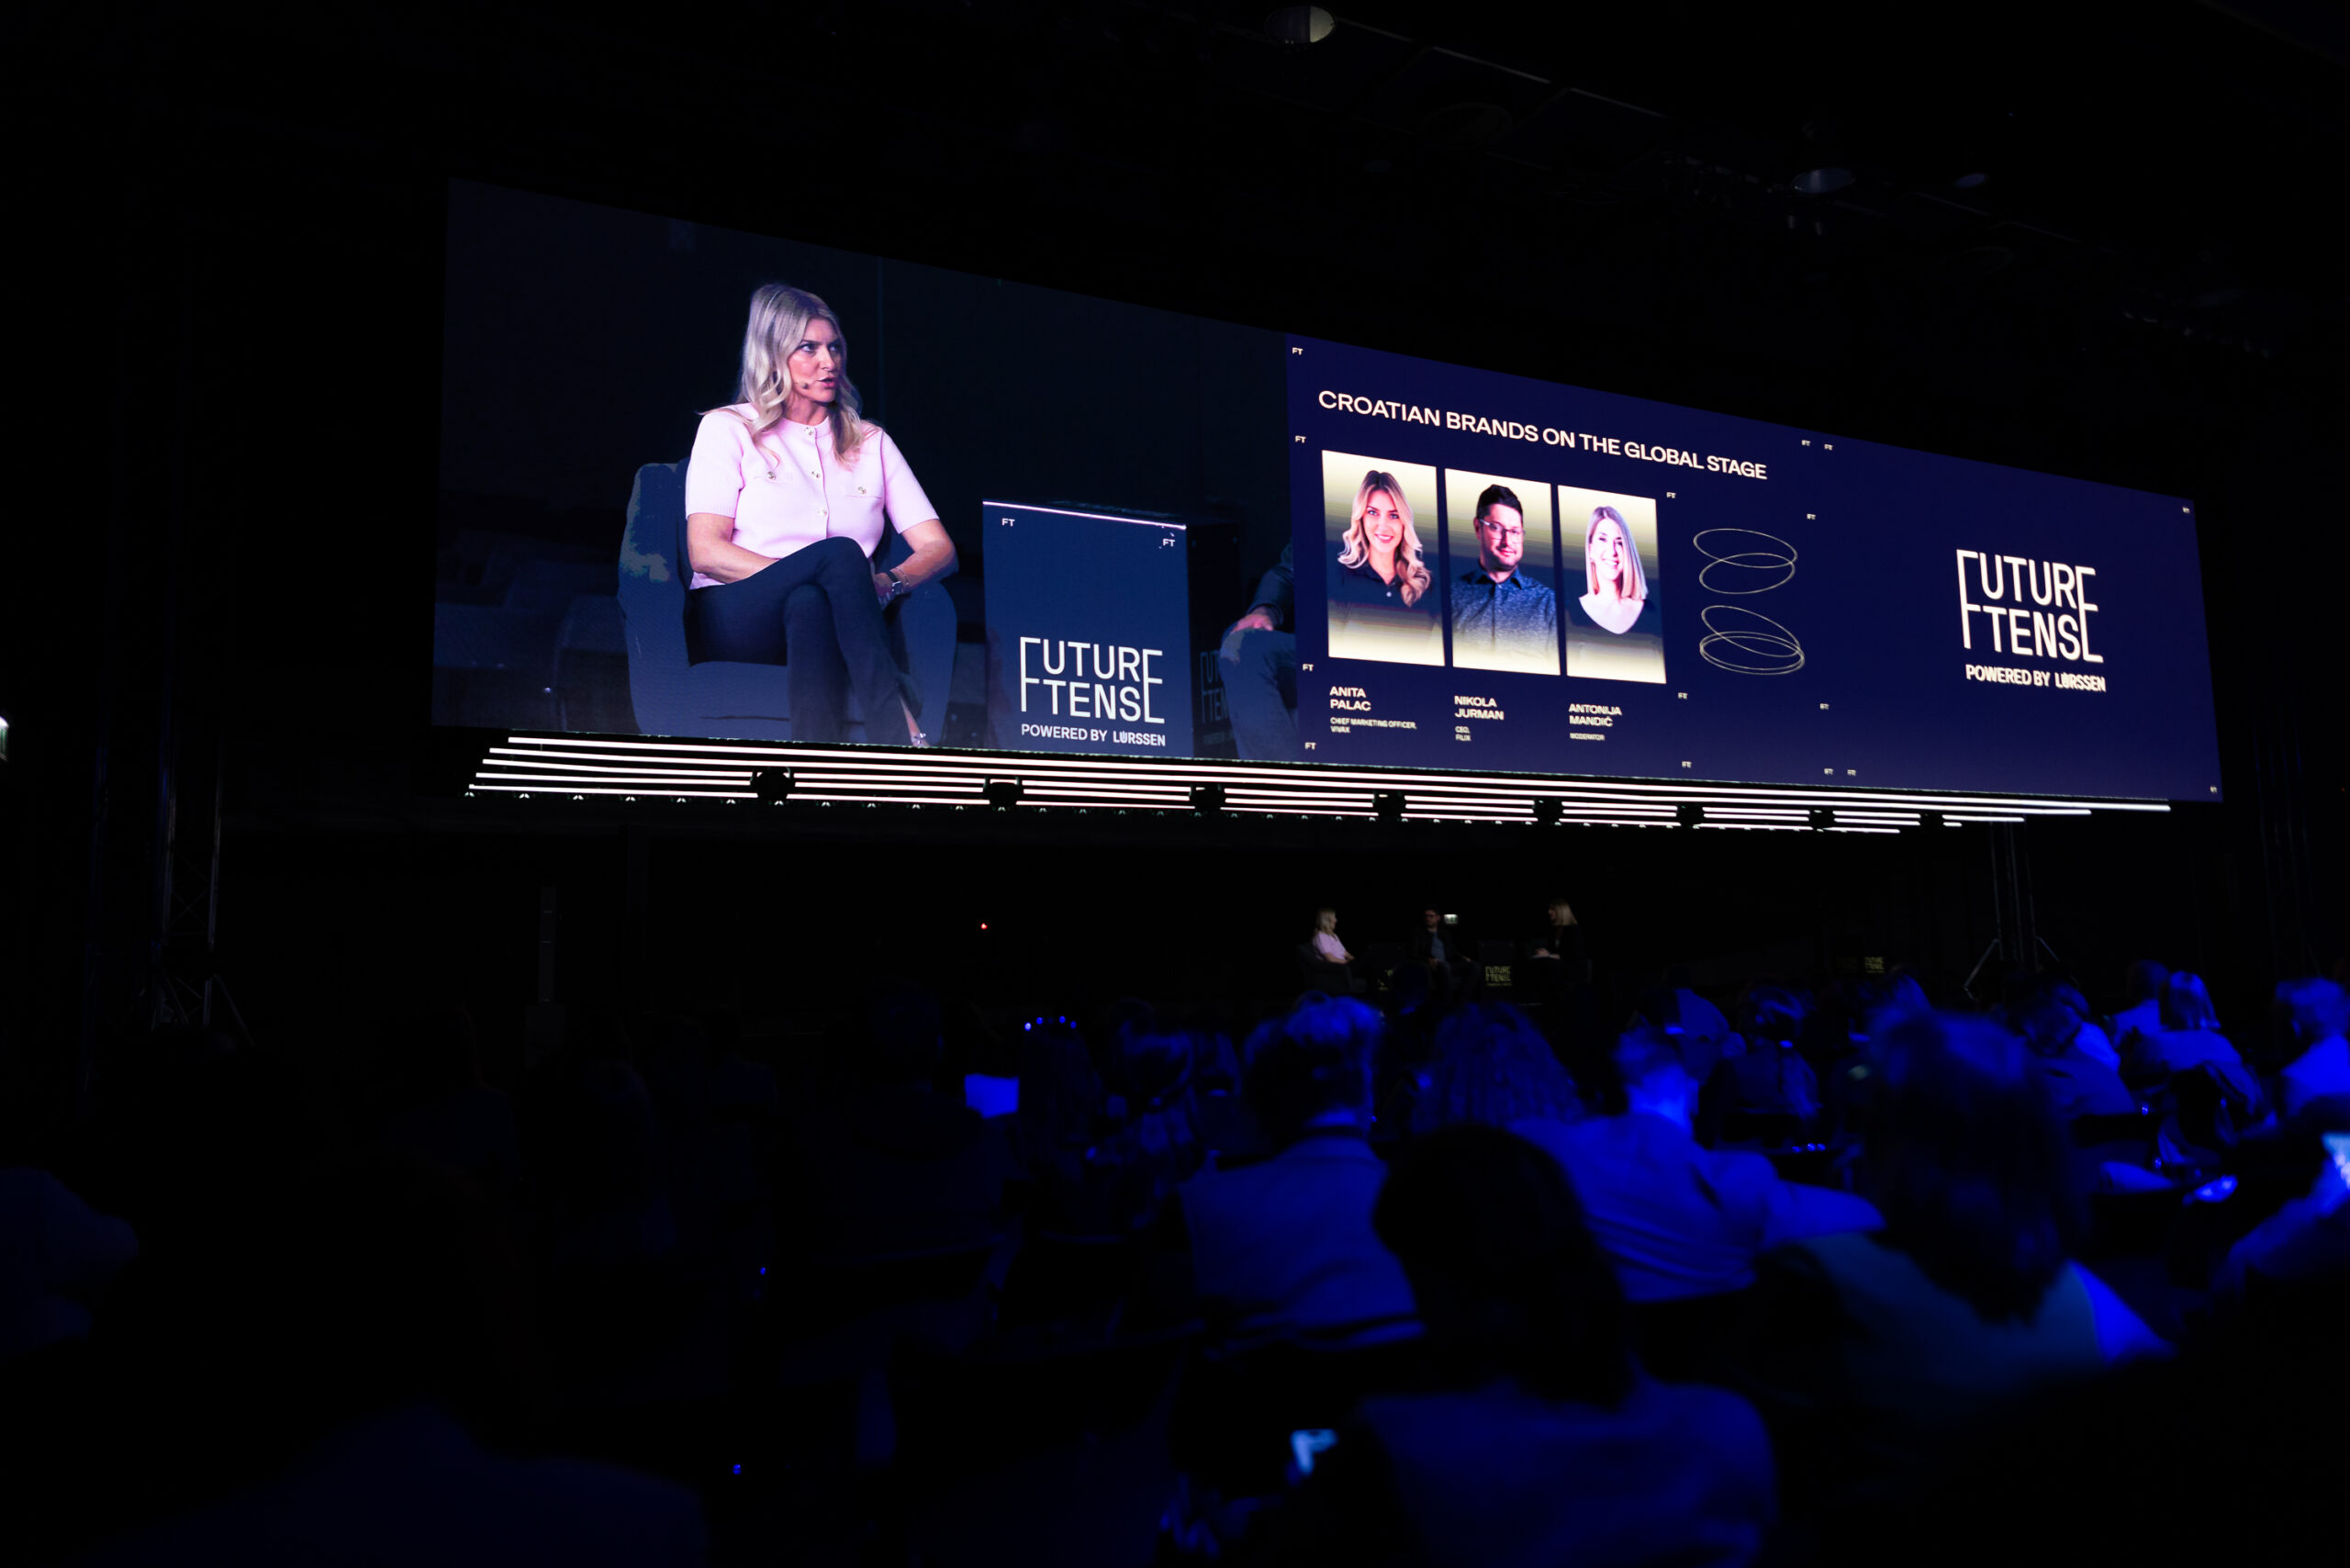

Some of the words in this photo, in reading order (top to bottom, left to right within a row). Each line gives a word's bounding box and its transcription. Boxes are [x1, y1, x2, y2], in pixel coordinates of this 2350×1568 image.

[1292, 347, 1304, 355] FT
[1294, 435, 1306, 444] FT
[1318, 390, 1440, 427] CROATIAN
[1446, 411, 1539, 442] BRANDS
[1542, 428, 1575, 449] ON
[1579, 433, 1621, 455] THE
[1624, 441, 1705, 469] GLOBAL
[1707, 455, 1768, 480] STAGE
[1002, 517, 1016, 527] FT
[1162, 538, 1176, 548] FT
[1956, 549, 2099, 610] FUTURE
[1020, 636, 1163, 685] FUTURE
[1302, 663, 1315, 672] FT
[1965, 664, 2032, 686] POWERED
[2033, 669, 2051, 688] BY
[1329, 686, 1367, 698] ANITA
[1329, 699, 1371, 711] PALAC
[1454, 695, 1498, 708] NIKOLA
[1454, 708, 1505, 721] JURMAN
[1568, 703, 1623, 716] ANTONIJA
[1330, 717, 1350, 725] CHIEF
[1350, 719, 1388, 728] MARKETING
[1021, 723, 1088, 741] POWERED
[1091, 729, 1108, 742] BY
[1304, 742, 1316, 750] FT
